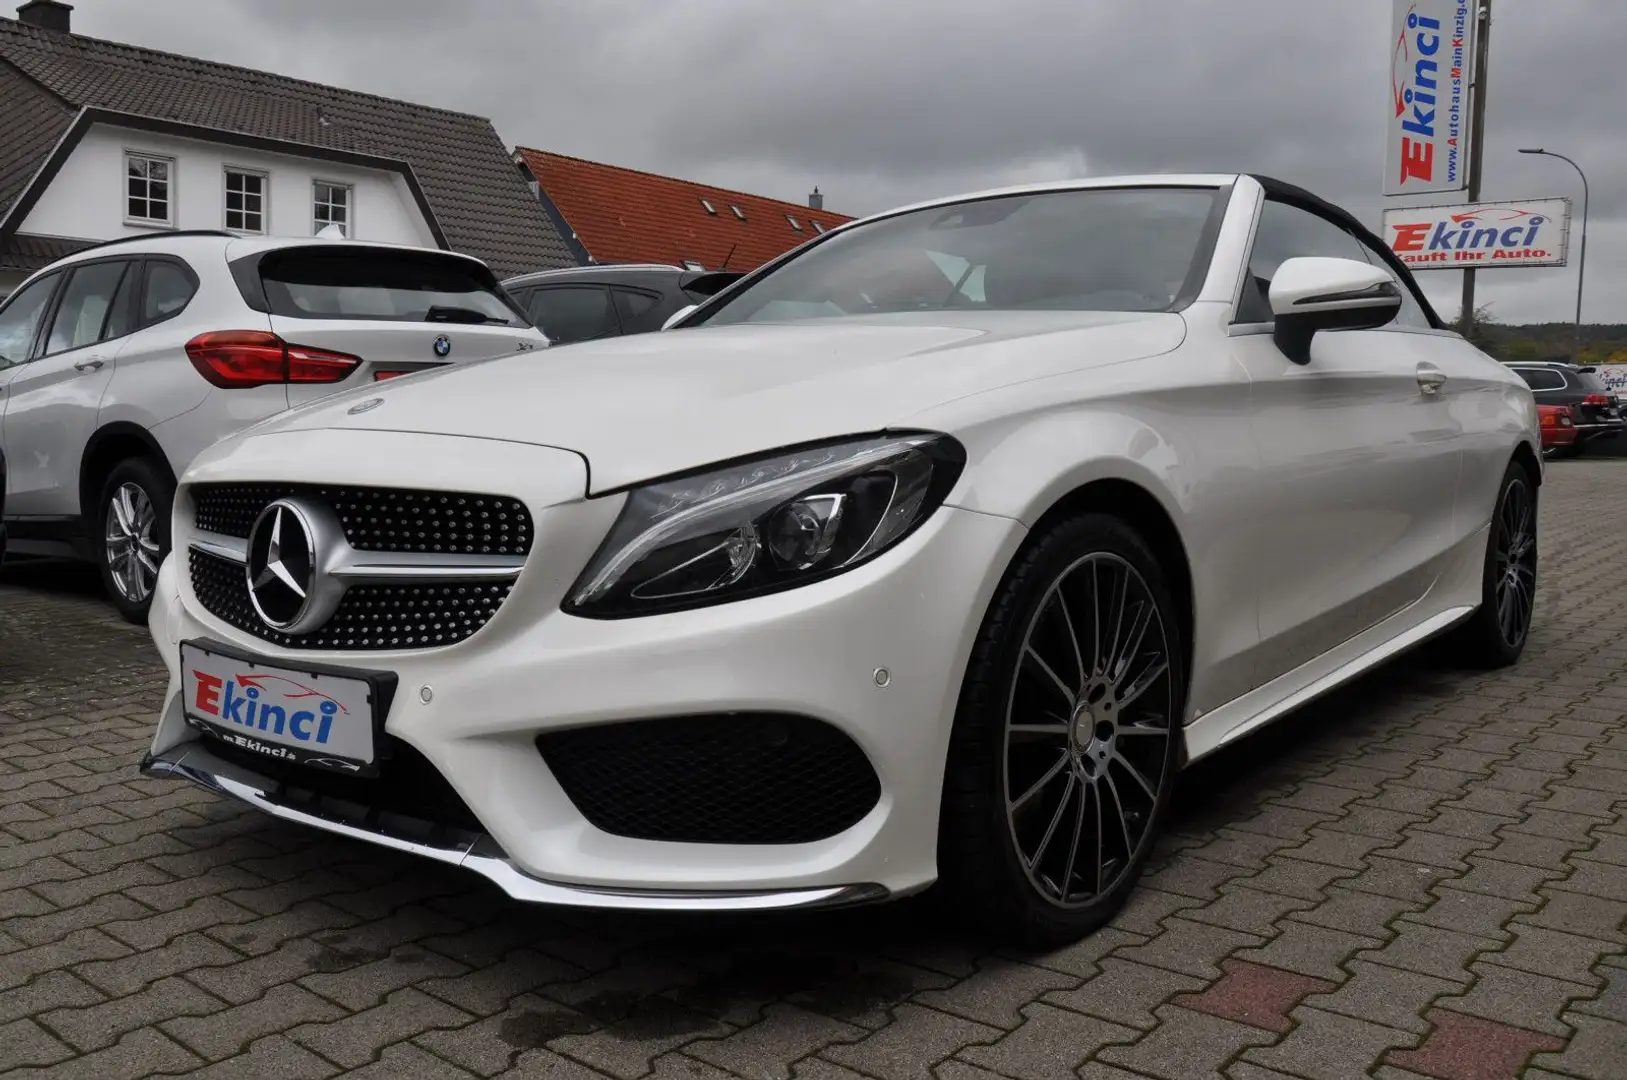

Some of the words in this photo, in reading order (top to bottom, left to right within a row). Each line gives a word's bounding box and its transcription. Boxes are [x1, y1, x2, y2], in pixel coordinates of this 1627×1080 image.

[1400, 13, 1440, 186] Ekinci
[1392, 216, 1544, 252] Ekinci
[1455, 251, 1486, 261] Ihr
[1492, 248, 1552, 260] Auto.
[192, 669, 337, 744] Ekinci
